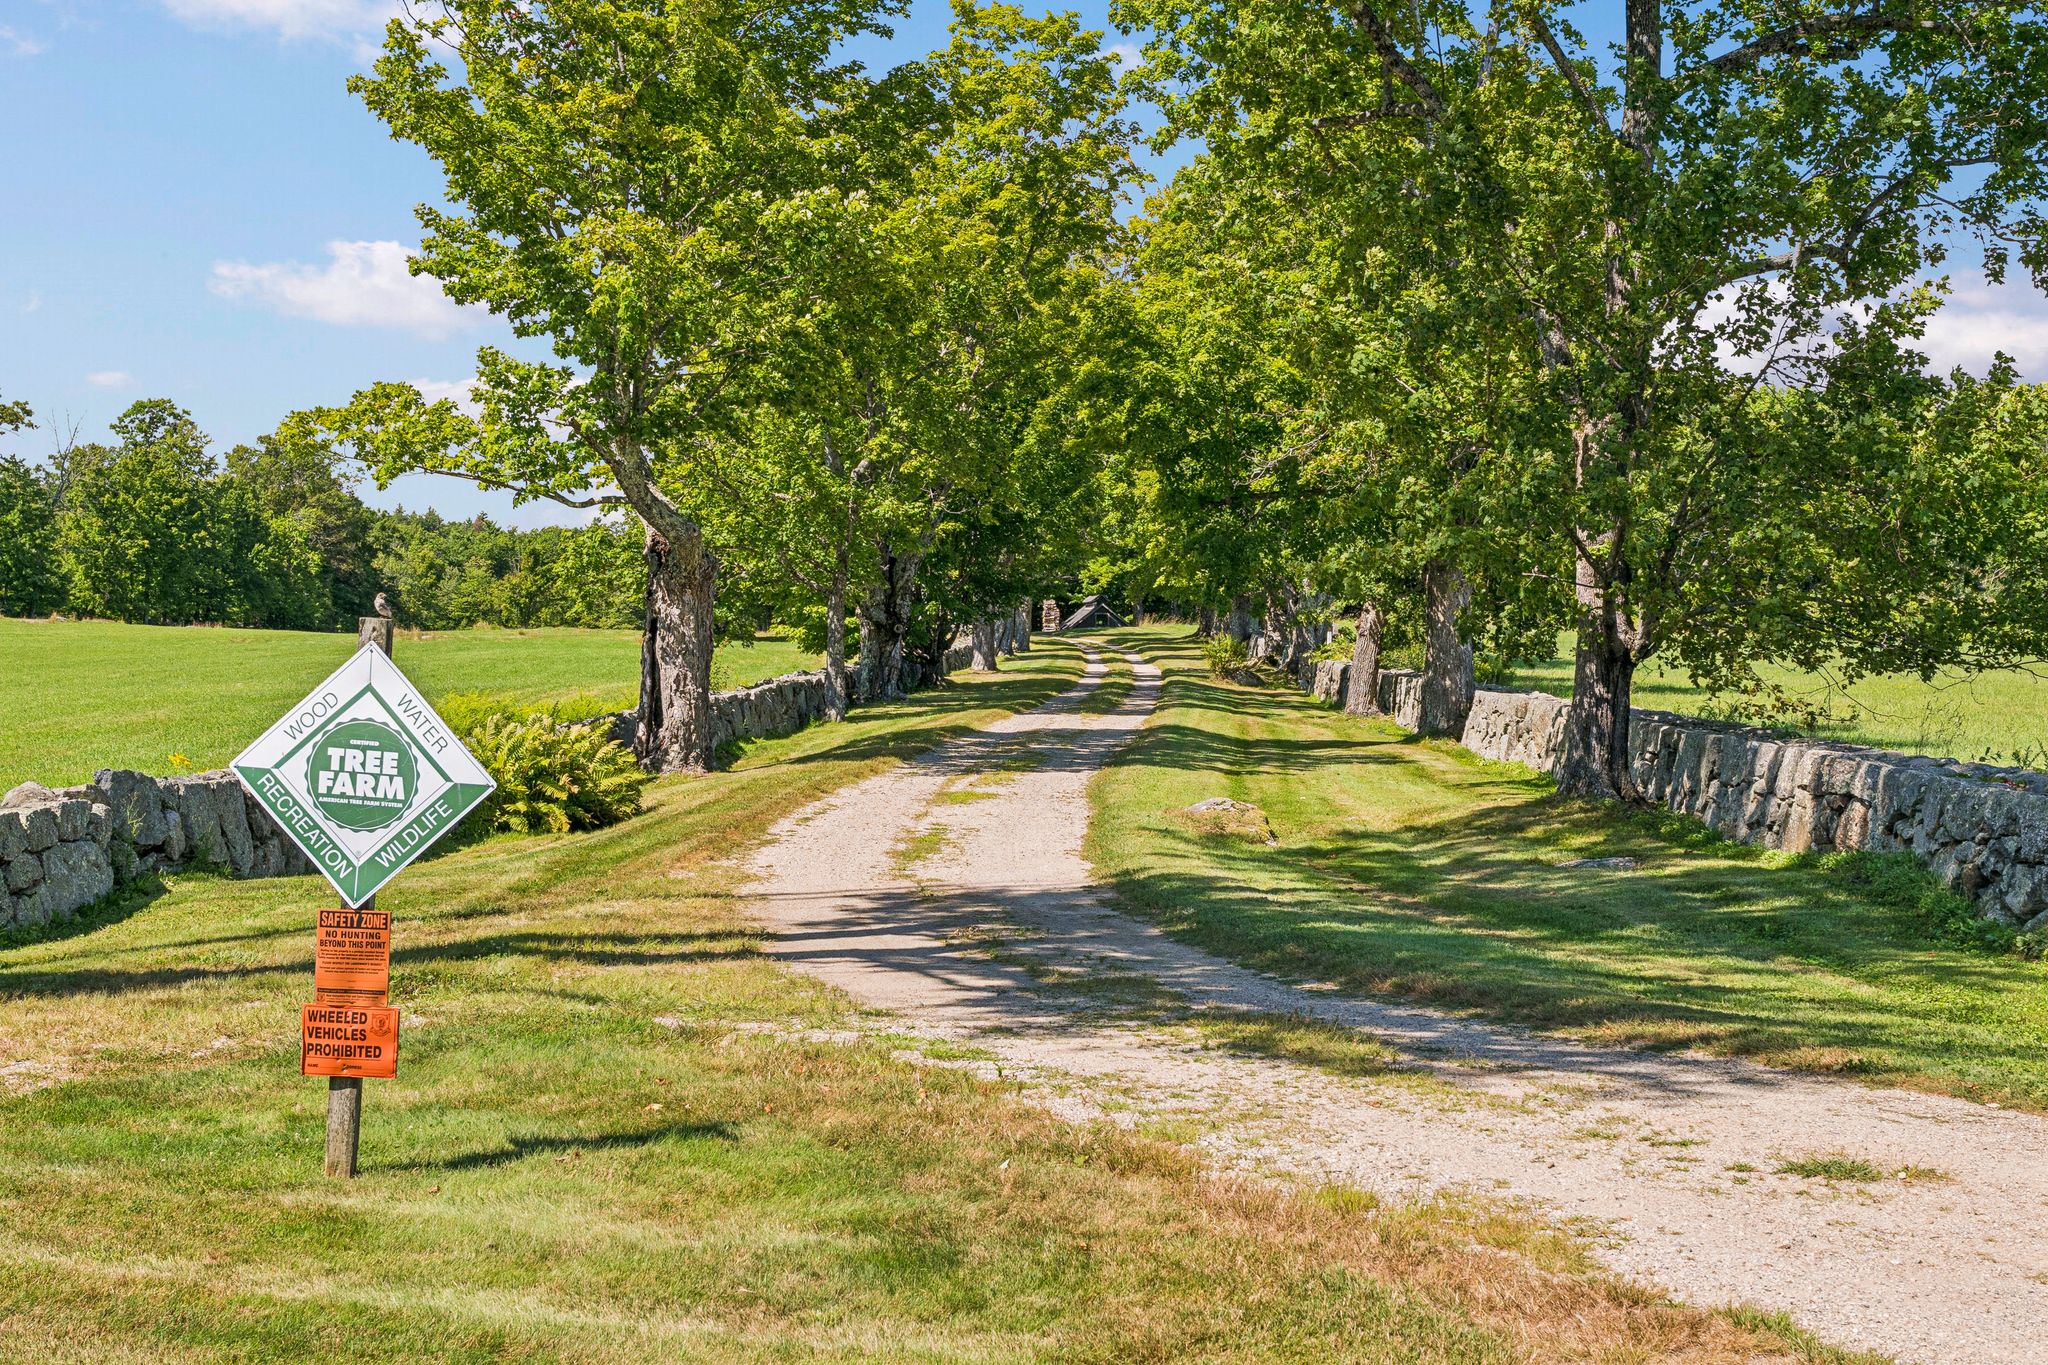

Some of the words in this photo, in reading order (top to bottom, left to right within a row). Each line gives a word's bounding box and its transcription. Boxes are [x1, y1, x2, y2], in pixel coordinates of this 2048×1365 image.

[284, 692, 338, 741] WOOD
[397, 693, 448, 754] WATER
[350, 739, 379, 747] CERTIFIED
[327, 747, 399, 775] TREE
[318, 770, 405, 800] FARM
[256, 773, 353, 879] RECREATION
[375, 799, 452, 868] WILDLIFE
[321, 912, 359, 928] SAFETY
[361, 913, 387, 929] ZONE
[325, 930, 338, 939] NO
[340, 931, 381, 940] HUNTING
[319, 939, 346, 948] BEYOND
[348, 940, 364, 949] THIS
[365, 941, 386, 950] POINT
[307, 1009, 368, 1025] WHEELED
[307, 1026, 367, 1042] VEHICLES
[306, 1043, 382, 1059] PROHIBITED
